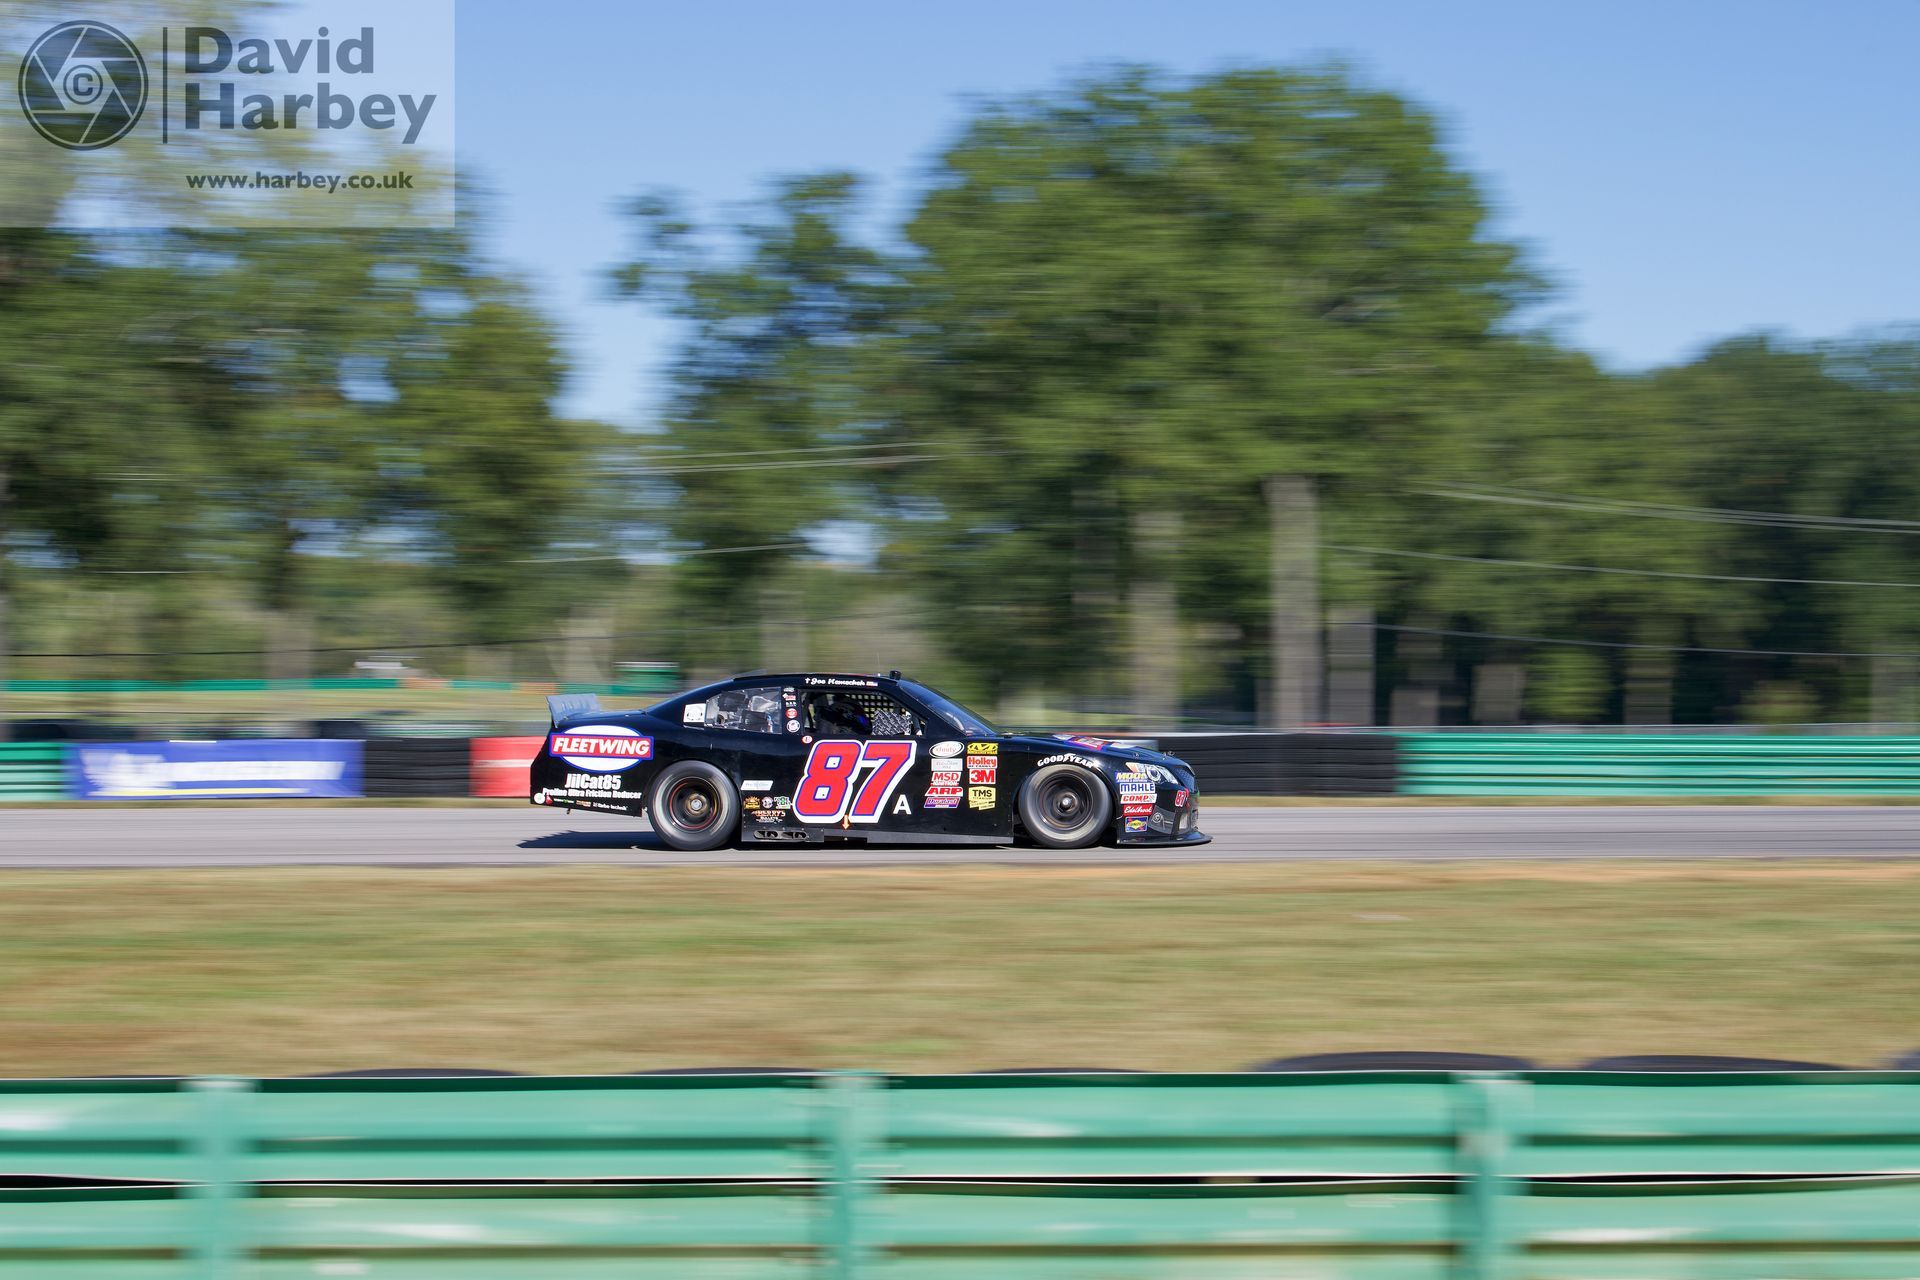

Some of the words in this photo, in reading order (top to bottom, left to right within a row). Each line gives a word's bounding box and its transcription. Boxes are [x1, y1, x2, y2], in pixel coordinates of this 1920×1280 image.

[553, 737, 650, 756] FLEETWING
[968, 757, 997, 767] Holley
[1037, 753, 1094, 769] GOODYEAR
[564, 773, 622, 790] JilCat85
[792, 739, 917, 824] 87
[933, 772, 960, 781] MSD
[970, 769, 995, 783] 3M
[927, 787, 963, 795] ARP
[972, 789, 992, 797] TMS
[1120, 783, 1155, 792] MAHLE
[585, 789, 612, 798] Friction
[612, 790, 642, 799] Reducer
[892, 794, 912, 815] A
